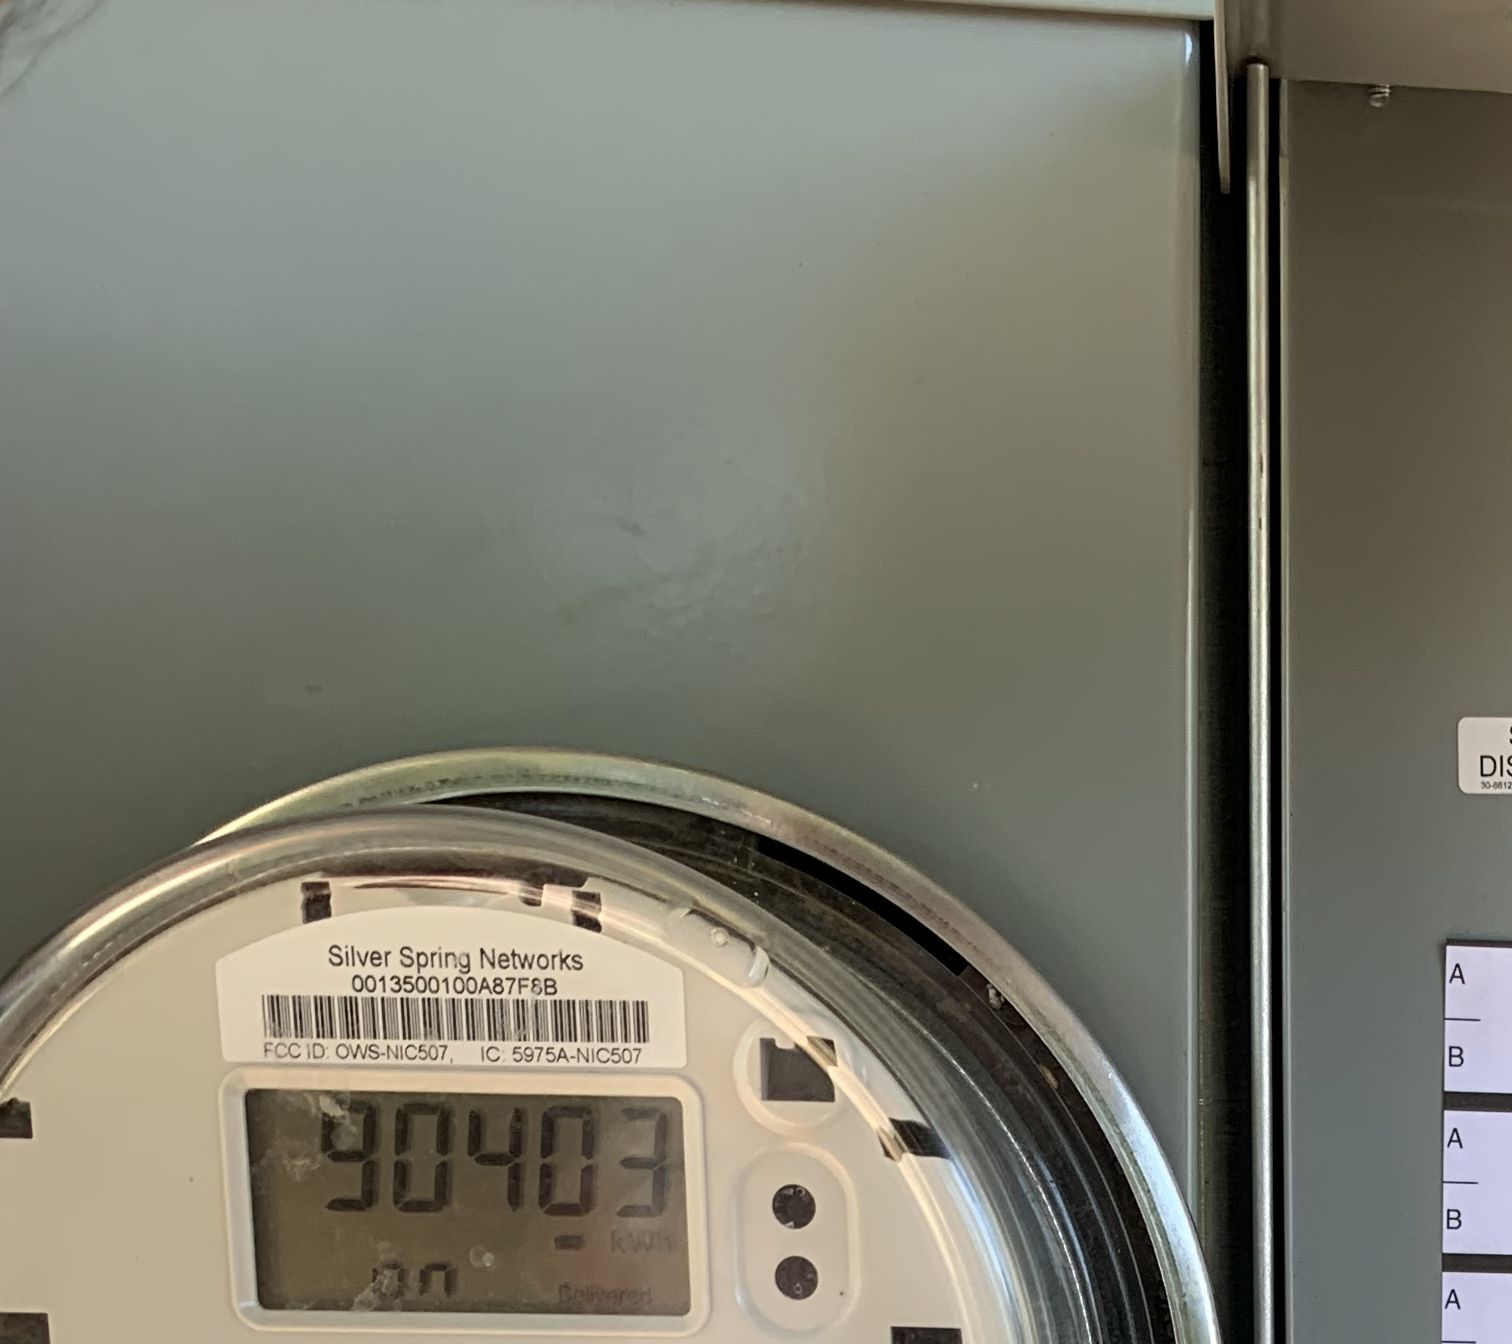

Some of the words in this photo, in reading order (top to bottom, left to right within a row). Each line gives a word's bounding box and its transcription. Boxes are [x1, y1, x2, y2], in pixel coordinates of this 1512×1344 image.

[328, 944, 391, 967] Silver
[400, 947, 470, 975] Spring
[480, 948, 584, 970] Networks
[1449, 963, 1465, 984] A
[351, 975, 558, 996] 0013500100A87F8B
[263, 1042, 301, 1059] FCC
[306, 1043, 329, 1059] ID:
[335, 1043, 454, 1064] OWS-NIC507,
[481, 1046, 505, 1062] IC:
[512, 1046, 641, 1064] 5975A-NIC507
[1448, 1046, 1464, 1067] B
[320, 1100, 669, 1218] 90403
[1445, 1289, 1461, 1310] A
